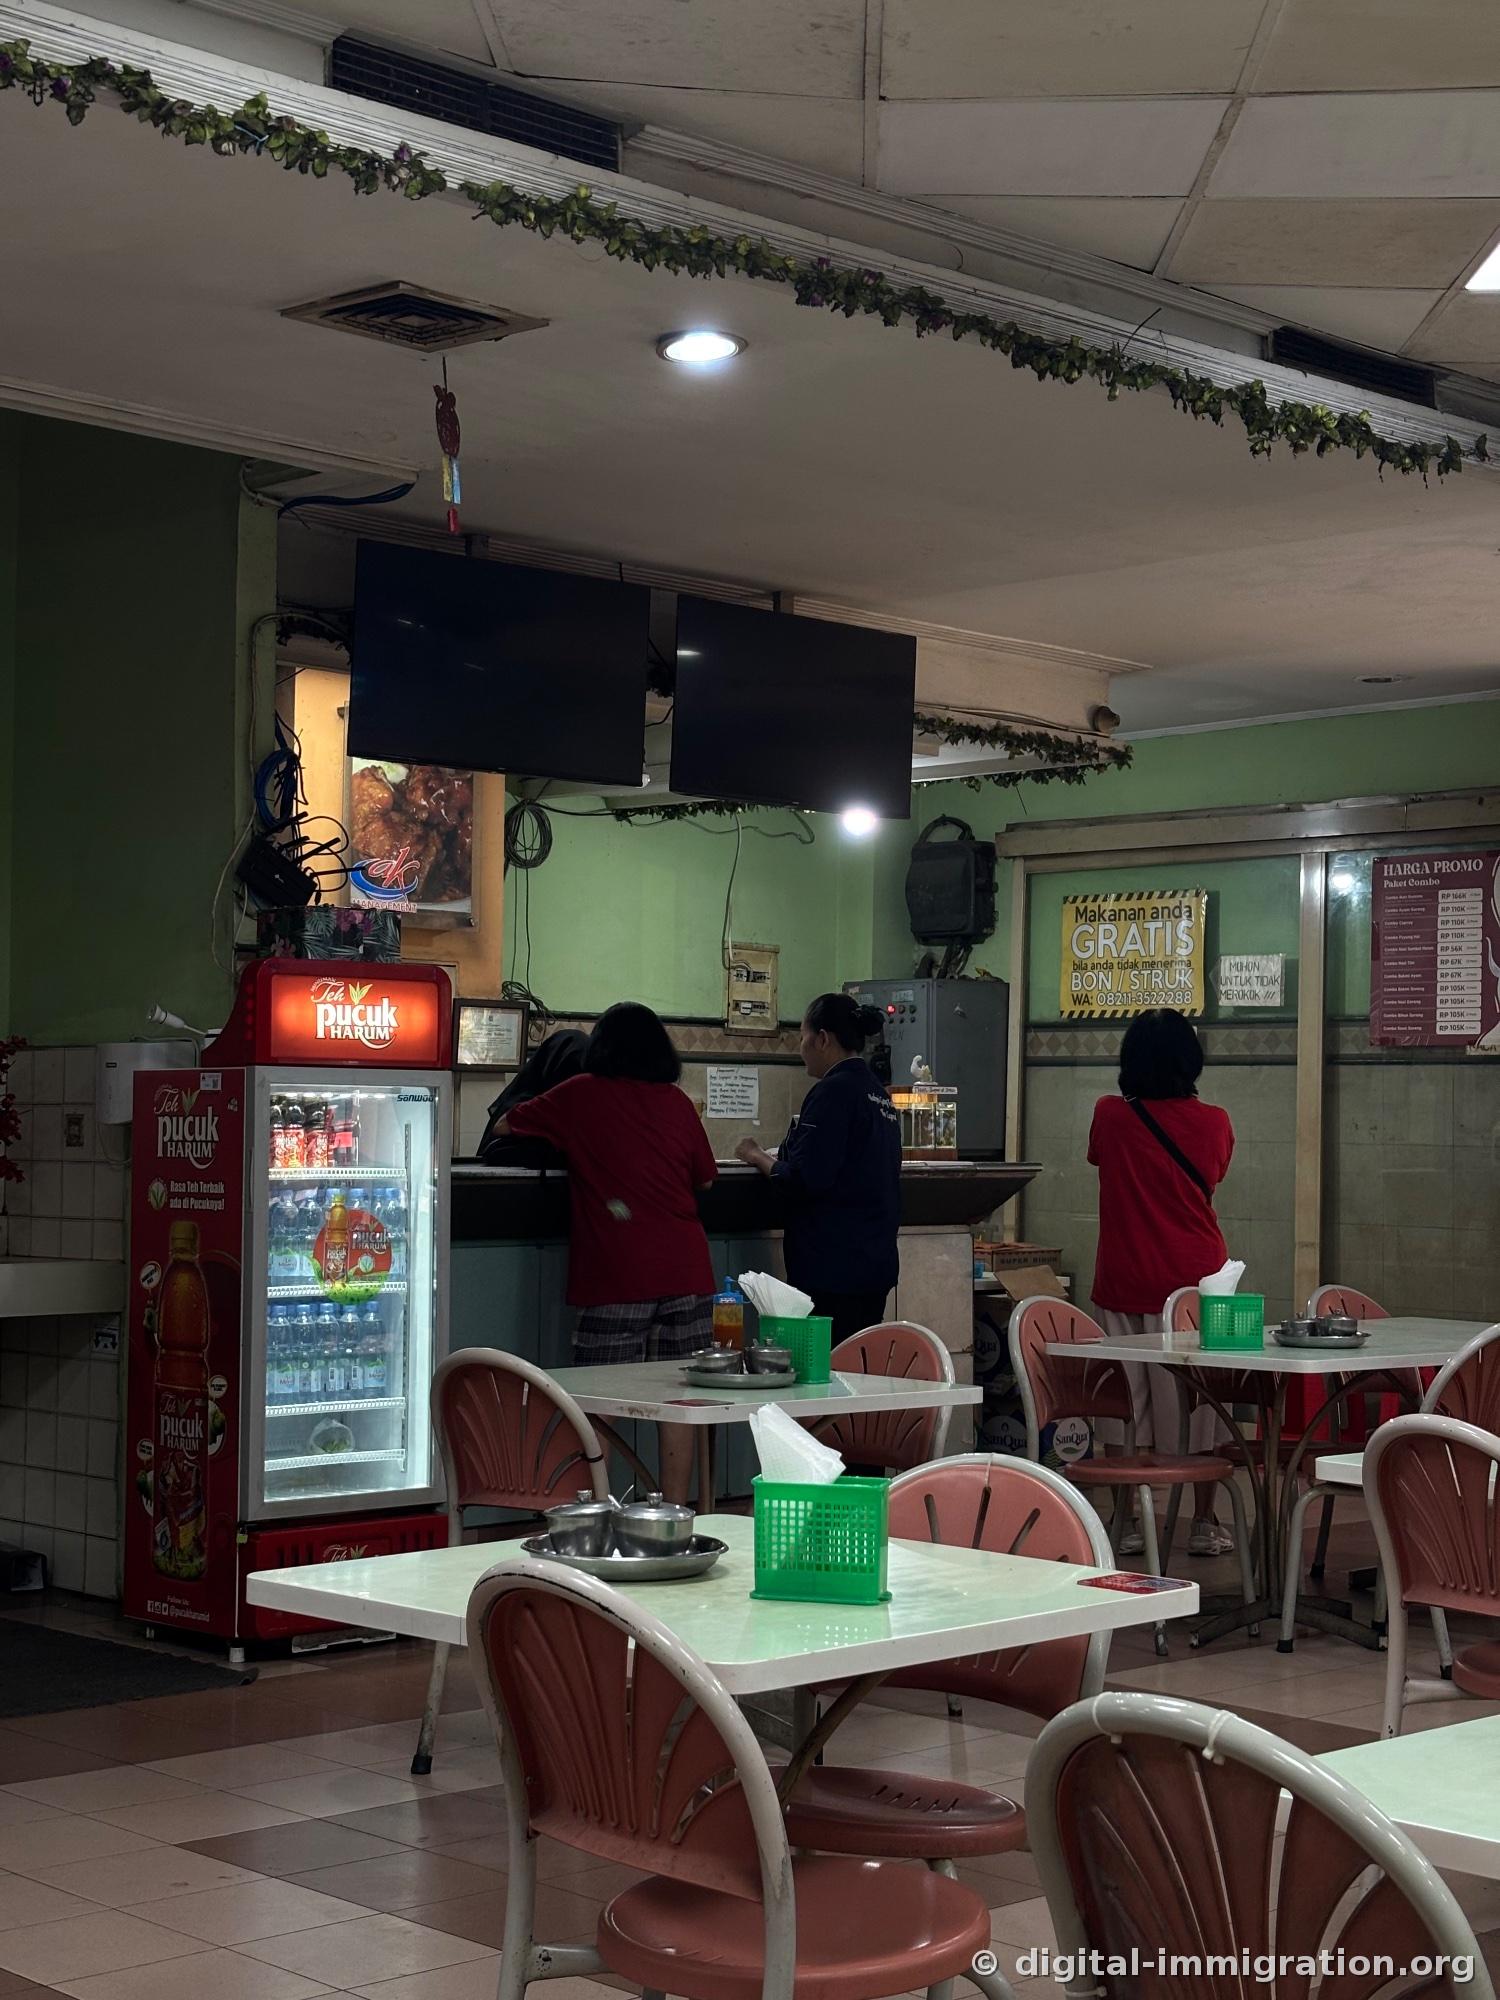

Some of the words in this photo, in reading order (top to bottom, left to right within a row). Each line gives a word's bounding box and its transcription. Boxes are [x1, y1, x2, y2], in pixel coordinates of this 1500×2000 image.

[1383, 862, 1431, 876] HARGA
[1432, 858, 1484, 873] PROMO
[1384, 879, 1407, 888] Paket
[1408, 877, 1440, 887] Combo
[1075, 903, 1146, 923] Makanan
[1150, 900, 1193, 920] anda
[1451, 918, 1465, 926] 110K
[1071, 919, 1195, 959] GRATIS
[1440, 932, 1450, 940] RP
[1440, 945, 1450, 953] RP
[1073, 960, 1089, 971] bila
[1090, 960, 1114, 970] anda
[1117, 959, 1140, 970] tidak
[1141, 959, 1192, 969] menerima
[1440, 958, 1449, 966] RP
[1071, 971, 1112, 991] BON
[1117, 971, 1125, 991] /
[1130, 968, 1194, 990] STRUK
[1220, 975, 1252, 986] UNTUK
[1254, 975, 1280, 986] TIDAK
[310, 981, 345, 1003] Teh
[1219, 989, 1261, 1000] MEROKOK
[1439, 985, 1449, 993] RP
[1072, 993, 1093, 1006] WA:
[1096, 991, 1192, 1006] 08211-3522288
[1449, 997, 1465, 1005] 105K
[315, 997, 400, 1040] pucuk
[1439, 1011, 1449, 1019] RP
[1449, 1010, 1465, 1018] 105K
[1439, 1024, 1449, 1032] RP
[330, 1026, 393, 1046] HARUM
[157, 1106, 219, 1158] pucuk
[167, 1141, 214, 1164] HARUM
[160, 1411, 204, 1446] pucuk
[1056, 1431, 1088, 1446] SanQua
